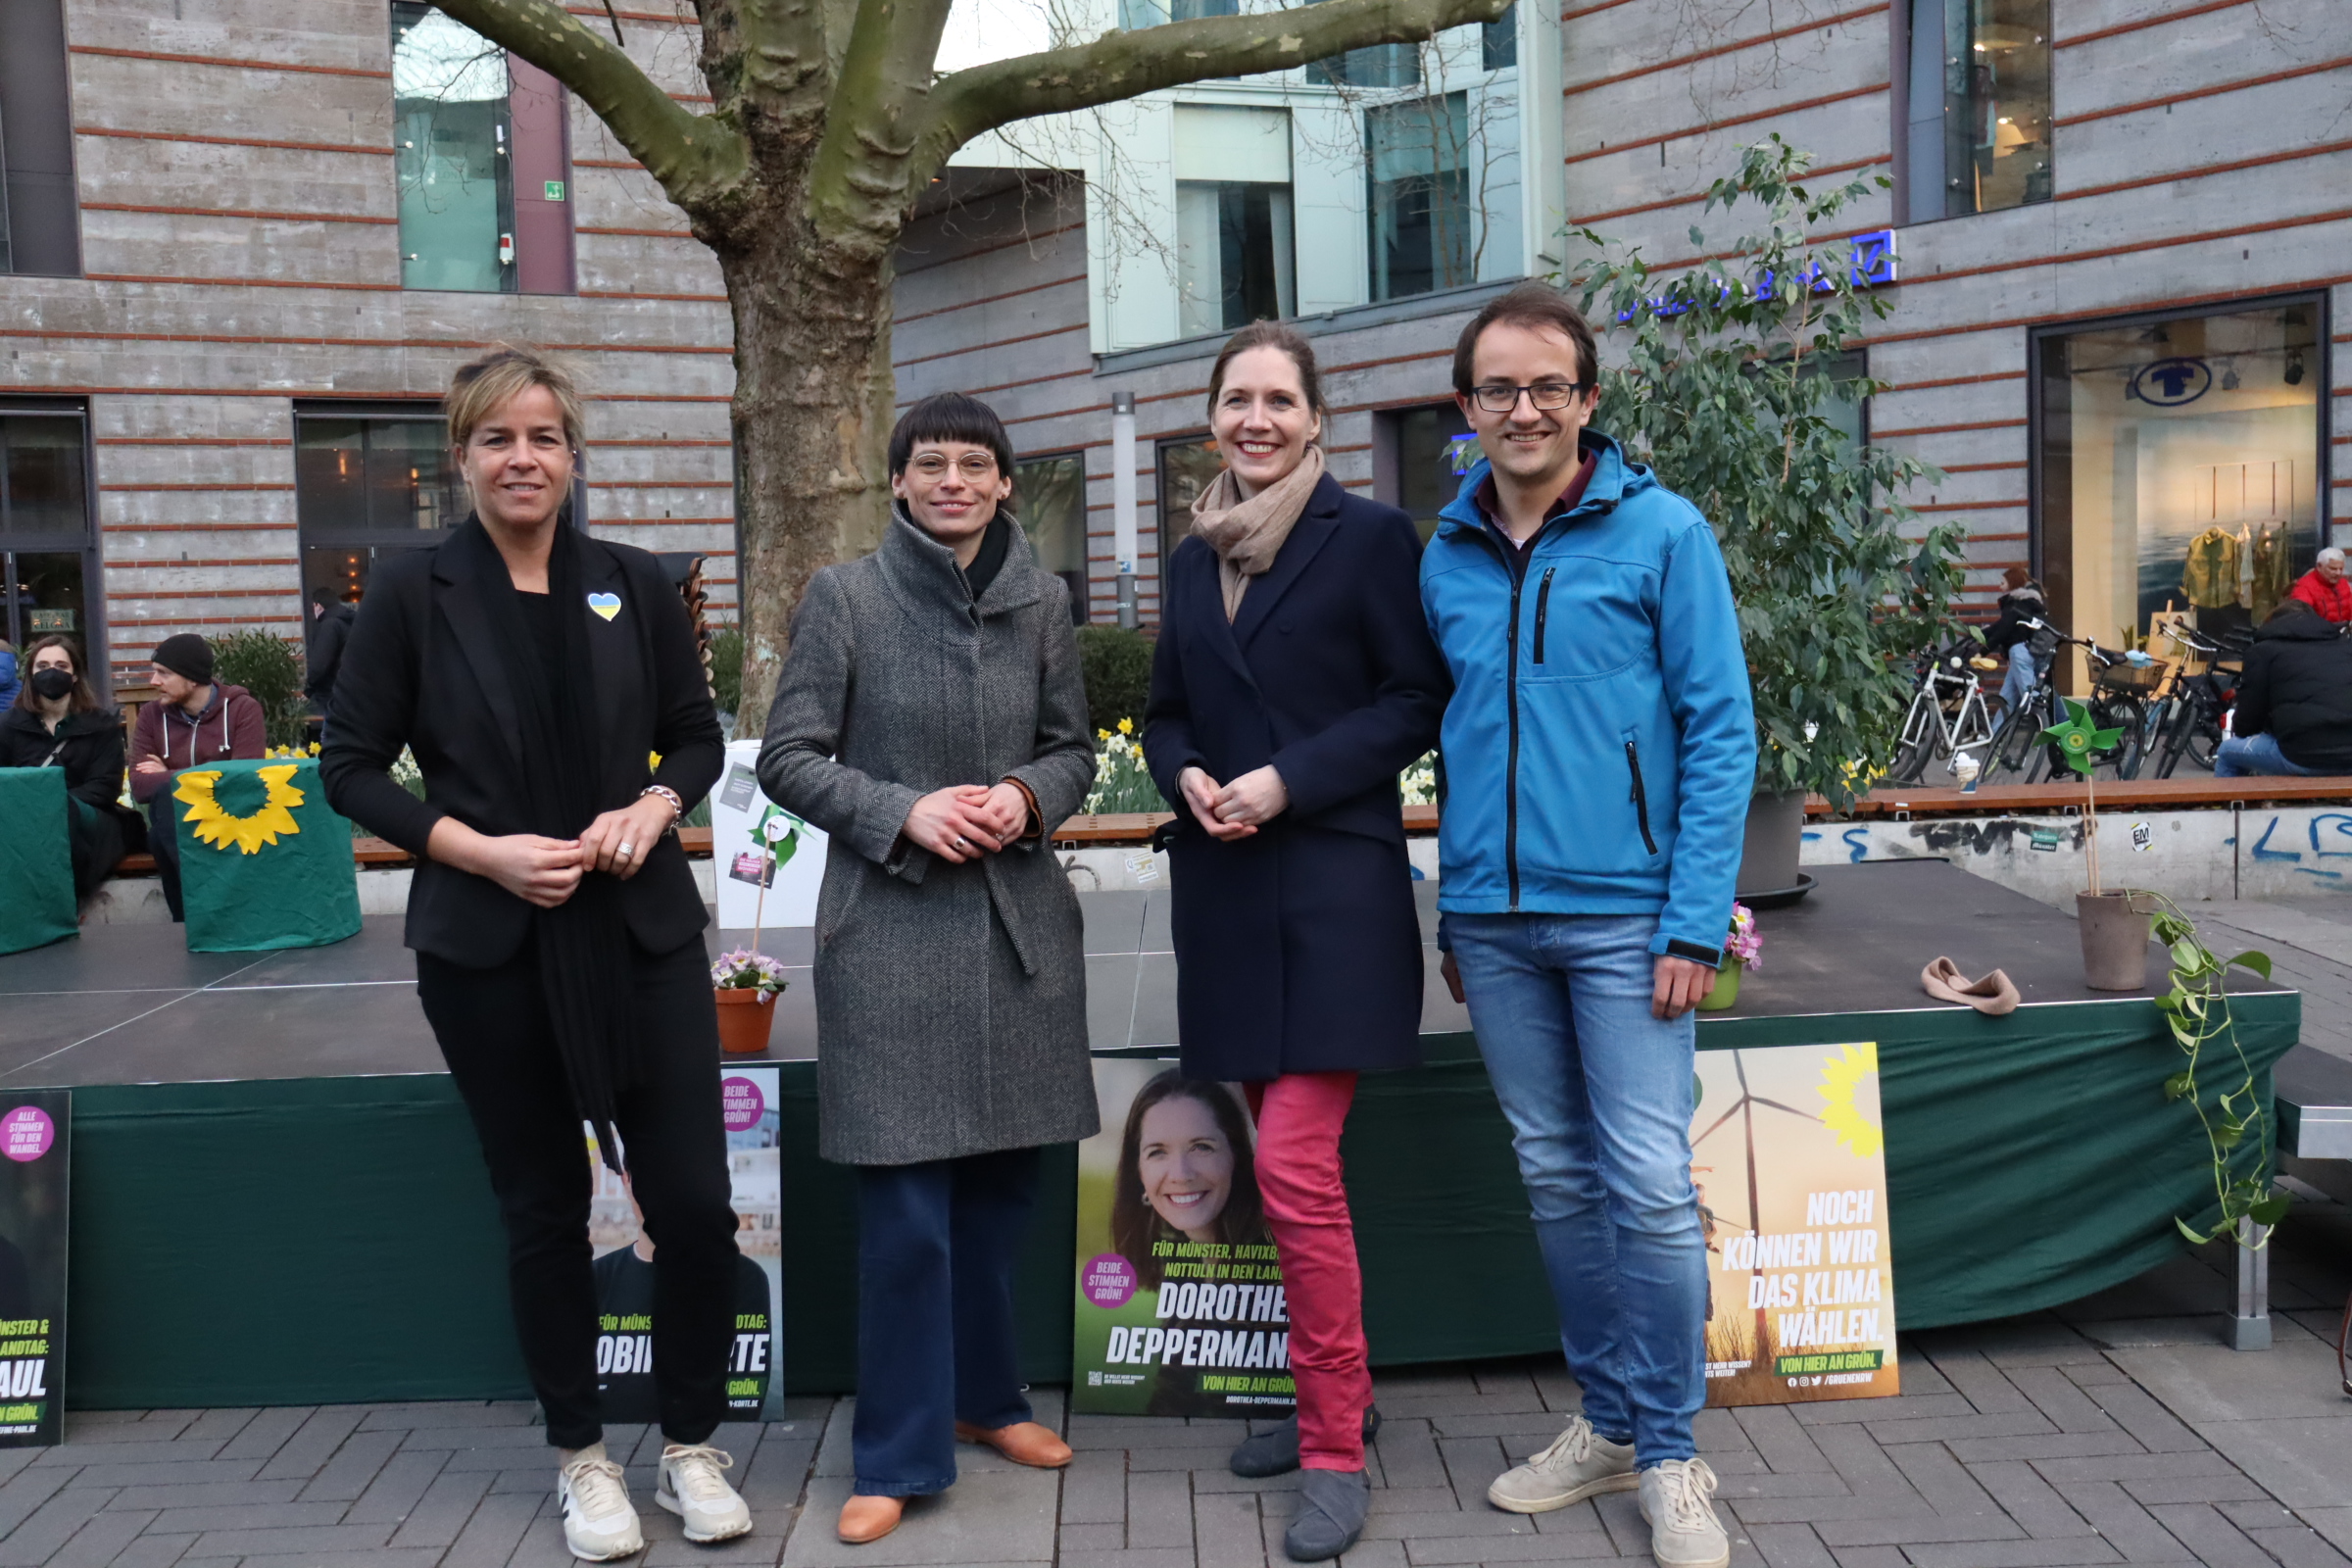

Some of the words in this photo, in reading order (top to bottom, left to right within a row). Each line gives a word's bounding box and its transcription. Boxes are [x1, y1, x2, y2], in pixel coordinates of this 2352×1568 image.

[724, 1086, 750, 1098] BEIDE
[18, 1111, 36, 1121] ALLE
[724, 1109, 752, 1123] GRÜN!
[9, 1122, 44, 1133] STIMMEN
[11, 1132, 26, 1144] FÜR
[26, 1133, 42, 1143] DEN
[10, 1144, 42, 1154] WANDEL.
[1806, 1189, 1875, 1226] NOCH
[1152, 1240, 1175, 1257] FÜR
[1176, 1241, 1232, 1259] MÜNSTER,
[1235, 1245, 1280, 1260] HAVIXB
[1722, 1230, 1823, 1271] KÖNNEN
[1828, 1229, 1878, 1265] WIR
[1097, 1261, 1122, 1274] BEIDE
[1164, 1262, 1215, 1279] NOTTULN
[1216, 1264, 1230, 1279] IN
[1231, 1264, 1254, 1280] DEN
[1088, 1274, 1130, 1288] STIMMEN
[1747, 1273, 1798, 1309] DAS
[1802, 1268, 1881, 1305] KLIMA
[1095, 1286, 1123, 1300] GRÜN!
[1155, 1282, 1291, 1323] DOROTHE
[0, 1319, 38, 1336] NSTER
[40, 1319, 50, 1334] &
[736, 1314, 767, 1329] DTAG:
[1779, 1305, 1884, 1348] WÄHLEN.
[728, 1334, 770, 1372] TE
[1106, 1326, 1291, 1369] DEPPERMAN
[1781, 1357, 1803, 1373] VON
[1803, 1354, 1828, 1372] HIER
[1829, 1354, 1845, 1370] AN
[1845, 1351, 1877, 1369] GRÜN.
[728, 1378, 760, 1396] GRÜN.
[1203, 1376, 1225, 1391] VON
[1225, 1376, 1250, 1392] HIER
[1250, 1377, 1268, 1393] AN
[1824, 1372, 1873, 1386] /GRUENENRW
[5, 1402, 38, 1422] GRÜN.
